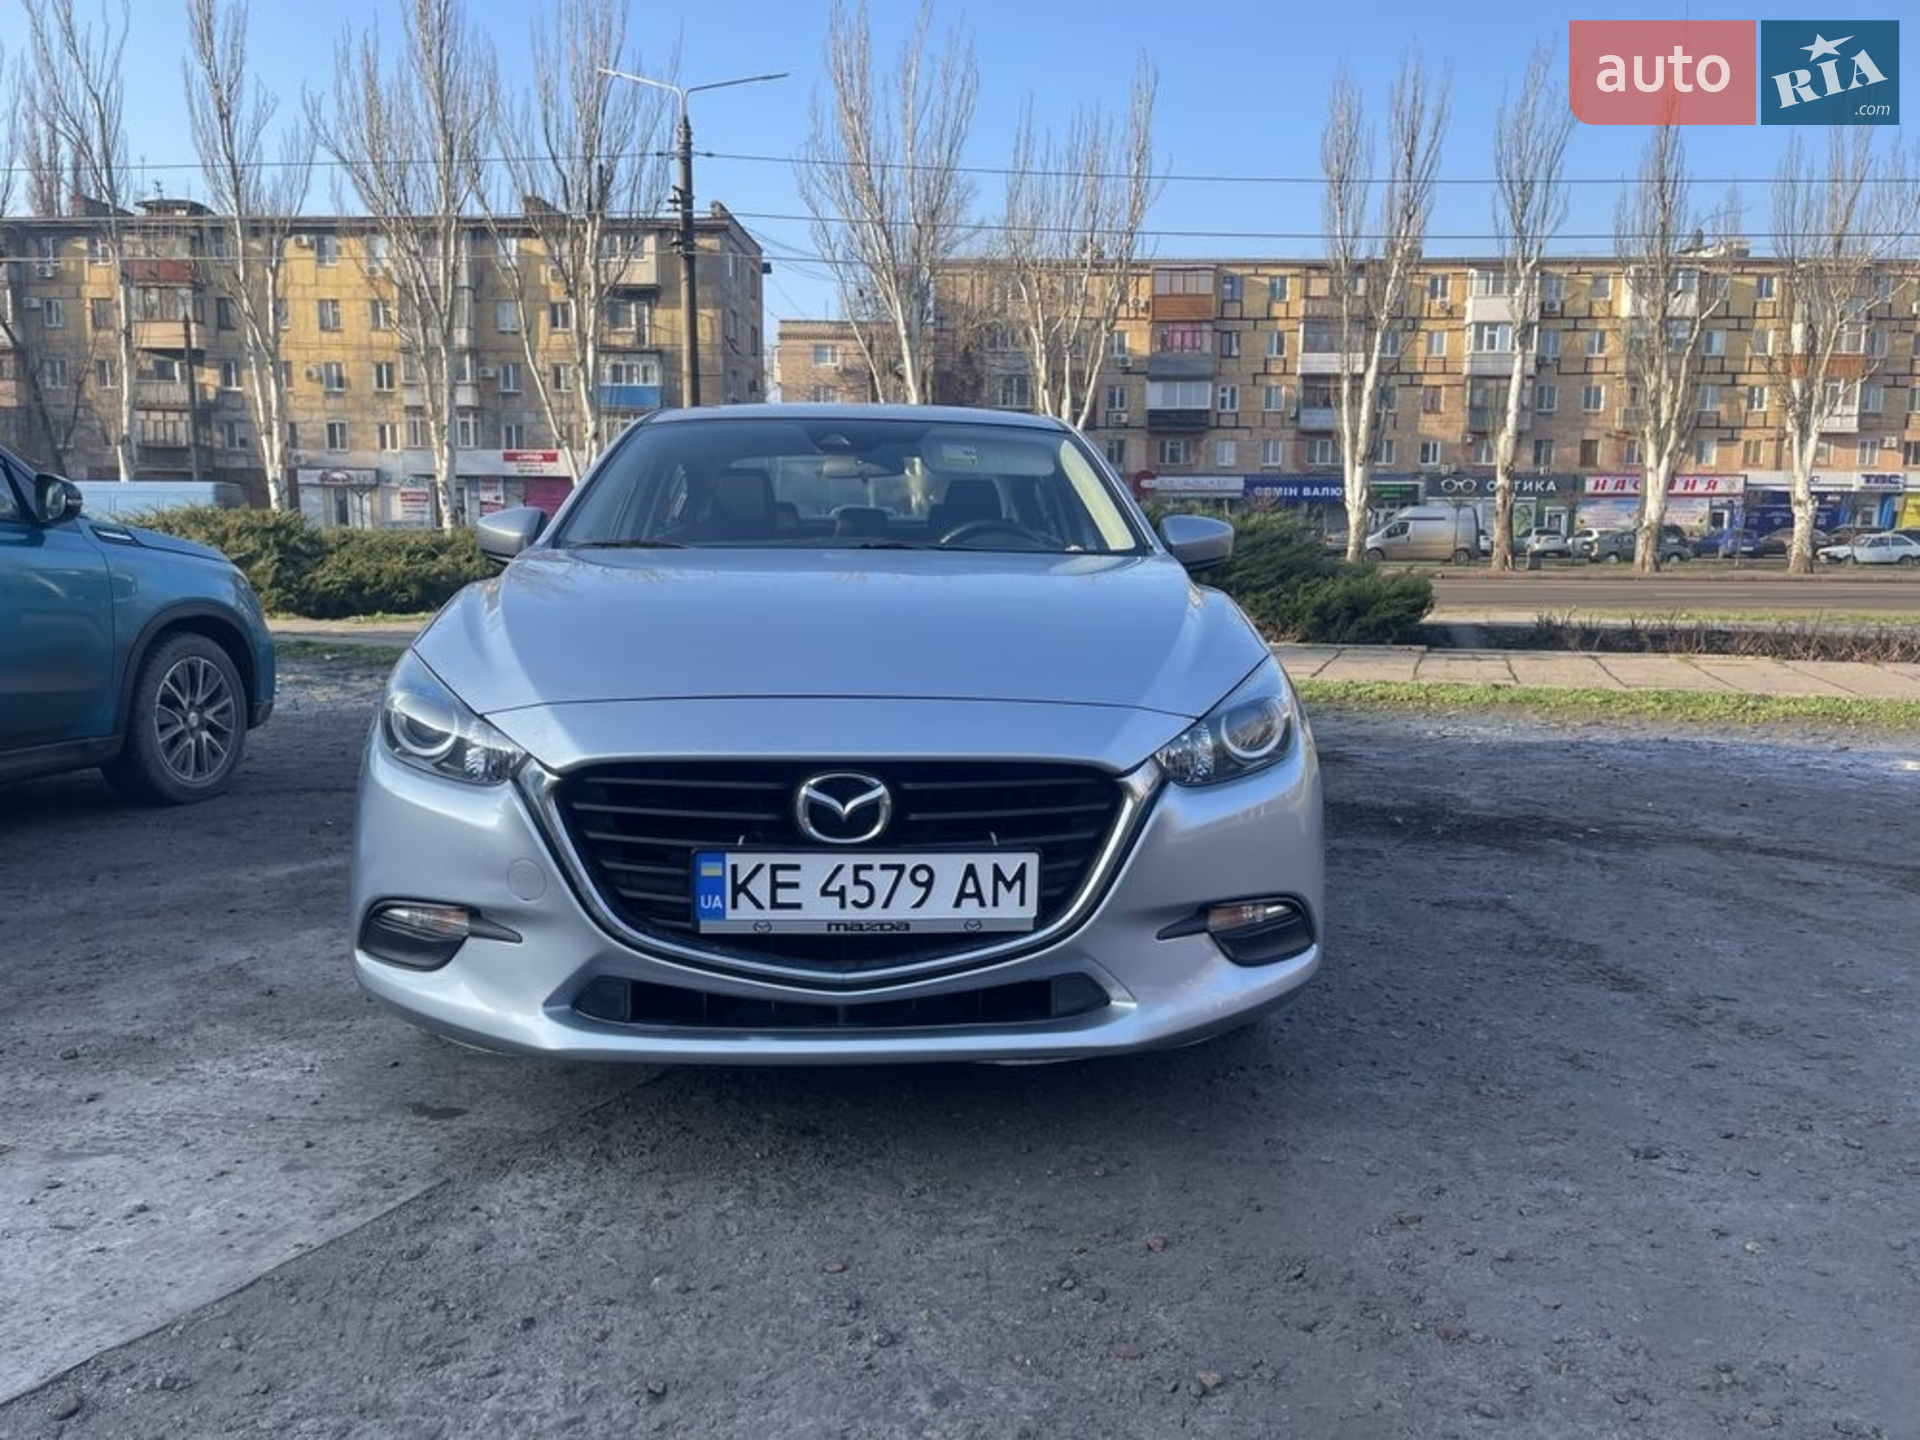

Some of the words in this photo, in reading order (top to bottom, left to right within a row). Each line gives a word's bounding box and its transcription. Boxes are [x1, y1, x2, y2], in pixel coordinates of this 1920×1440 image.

[1486, 480, 1557, 492] ОТИКА
[1593, 479, 1719, 491] НАСНЯ
[1302, 486, 1347, 497] ВАЛЮ
[730, 863, 803, 911] KE
[819, 862, 936, 910] 4579
[952, 861, 1027, 909] AM
[700, 894, 723, 909] UA
